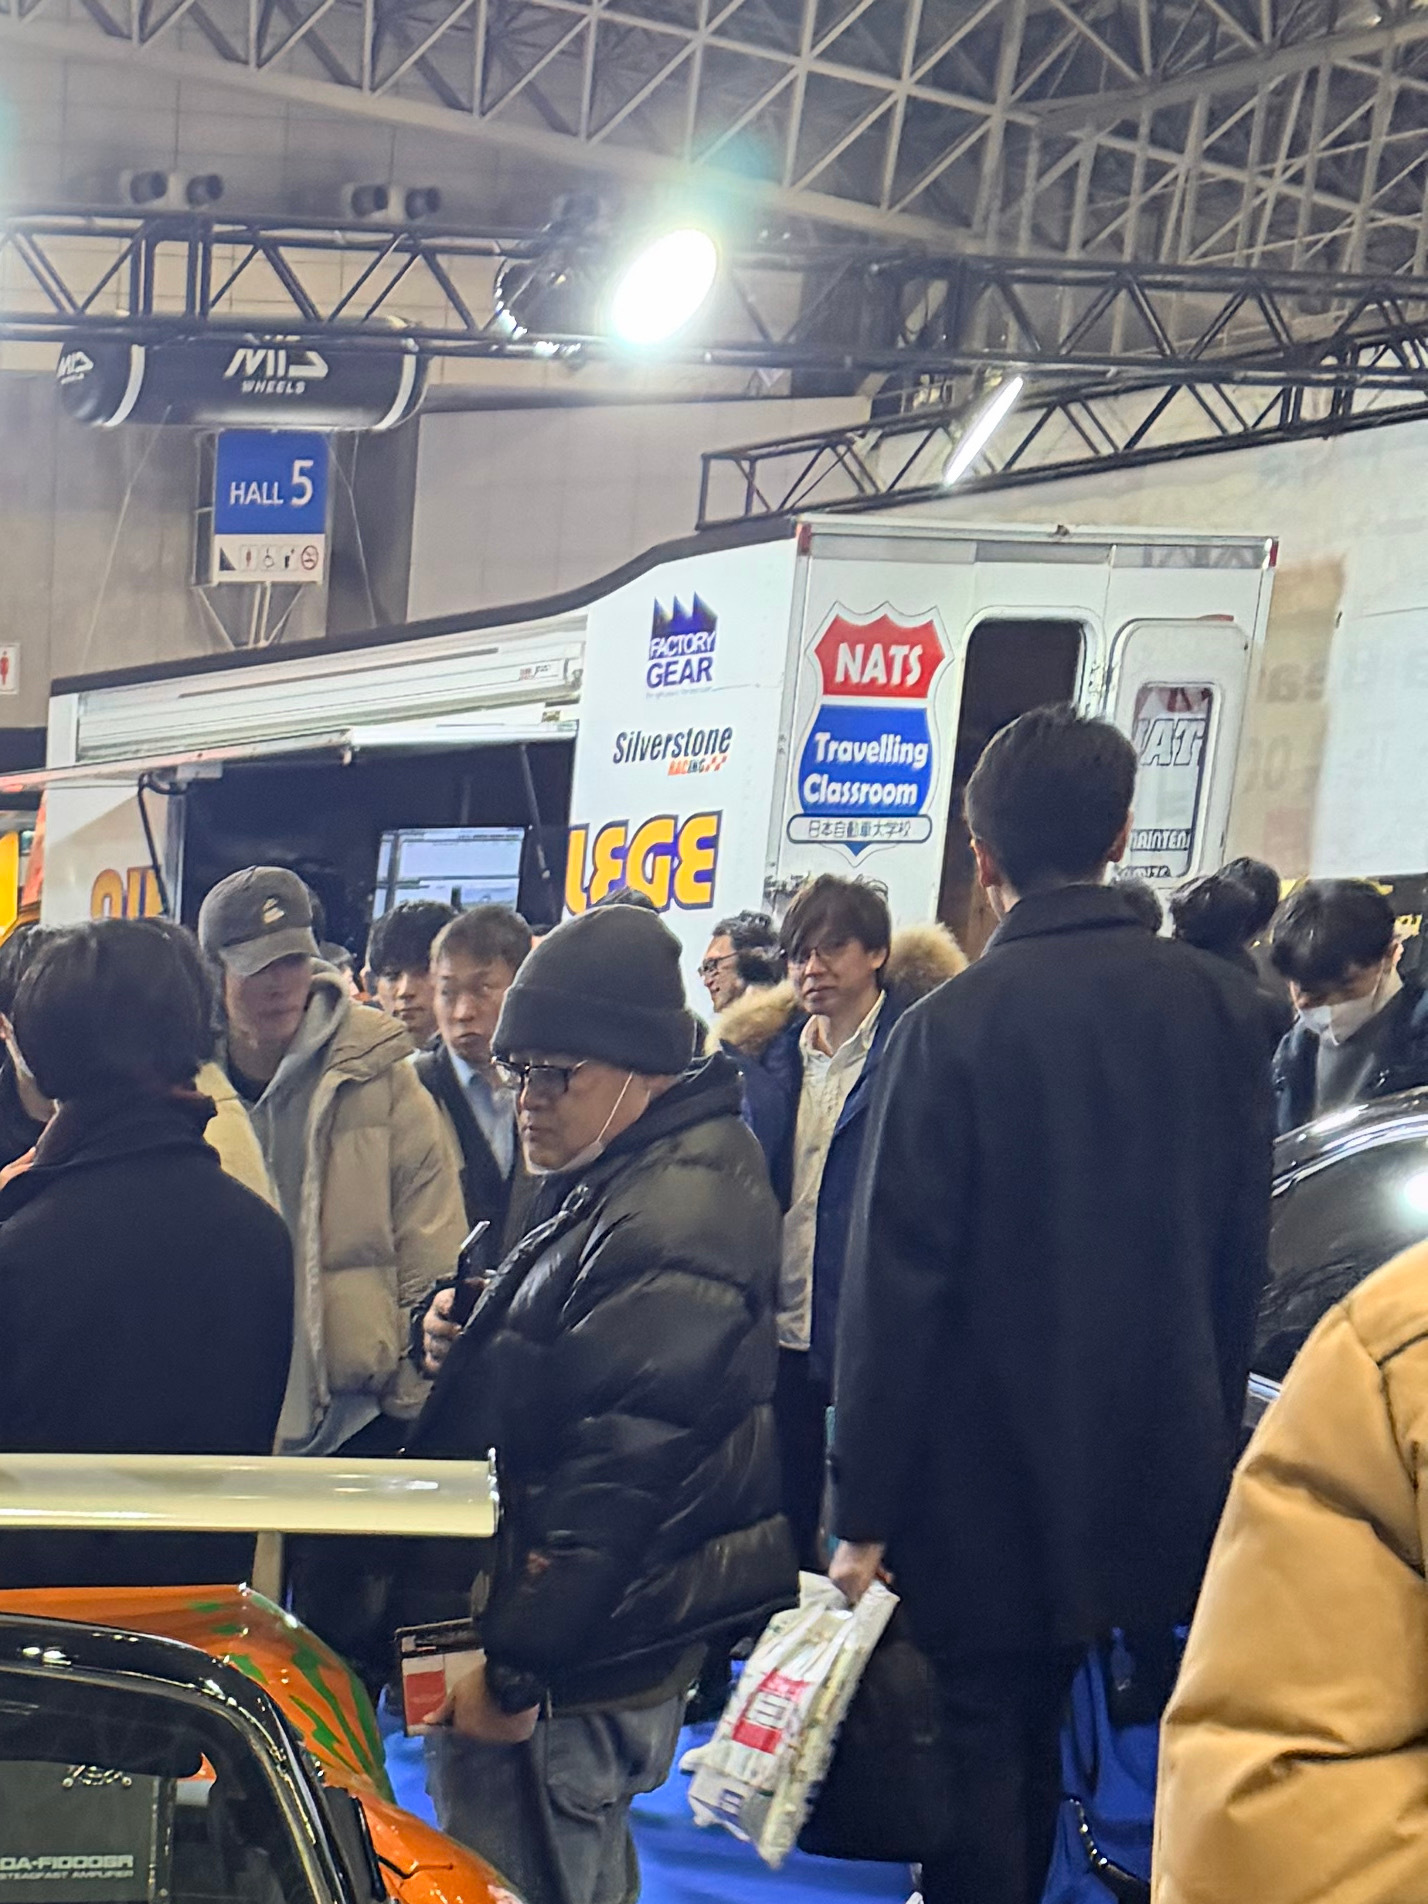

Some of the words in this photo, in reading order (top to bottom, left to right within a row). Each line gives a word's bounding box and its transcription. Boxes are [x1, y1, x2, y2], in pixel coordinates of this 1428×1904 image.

[241, 380, 306, 394] WHEELS
[229, 481, 284, 505] HALL
[291, 459, 314, 506] 5
[652, 631, 716, 659] FACTORY
[646, 656, 713, 689] GEAR
[835, 642, 923, 687] NATS
[612, 726, 733, 764] Silverstone
[815, 732, 929, 770] Travelling
[667, 758, 706, 776] RACING
[803, 773, 918, 806] Classroom
[808, 819, 912, 838] 日本自動車大学校
